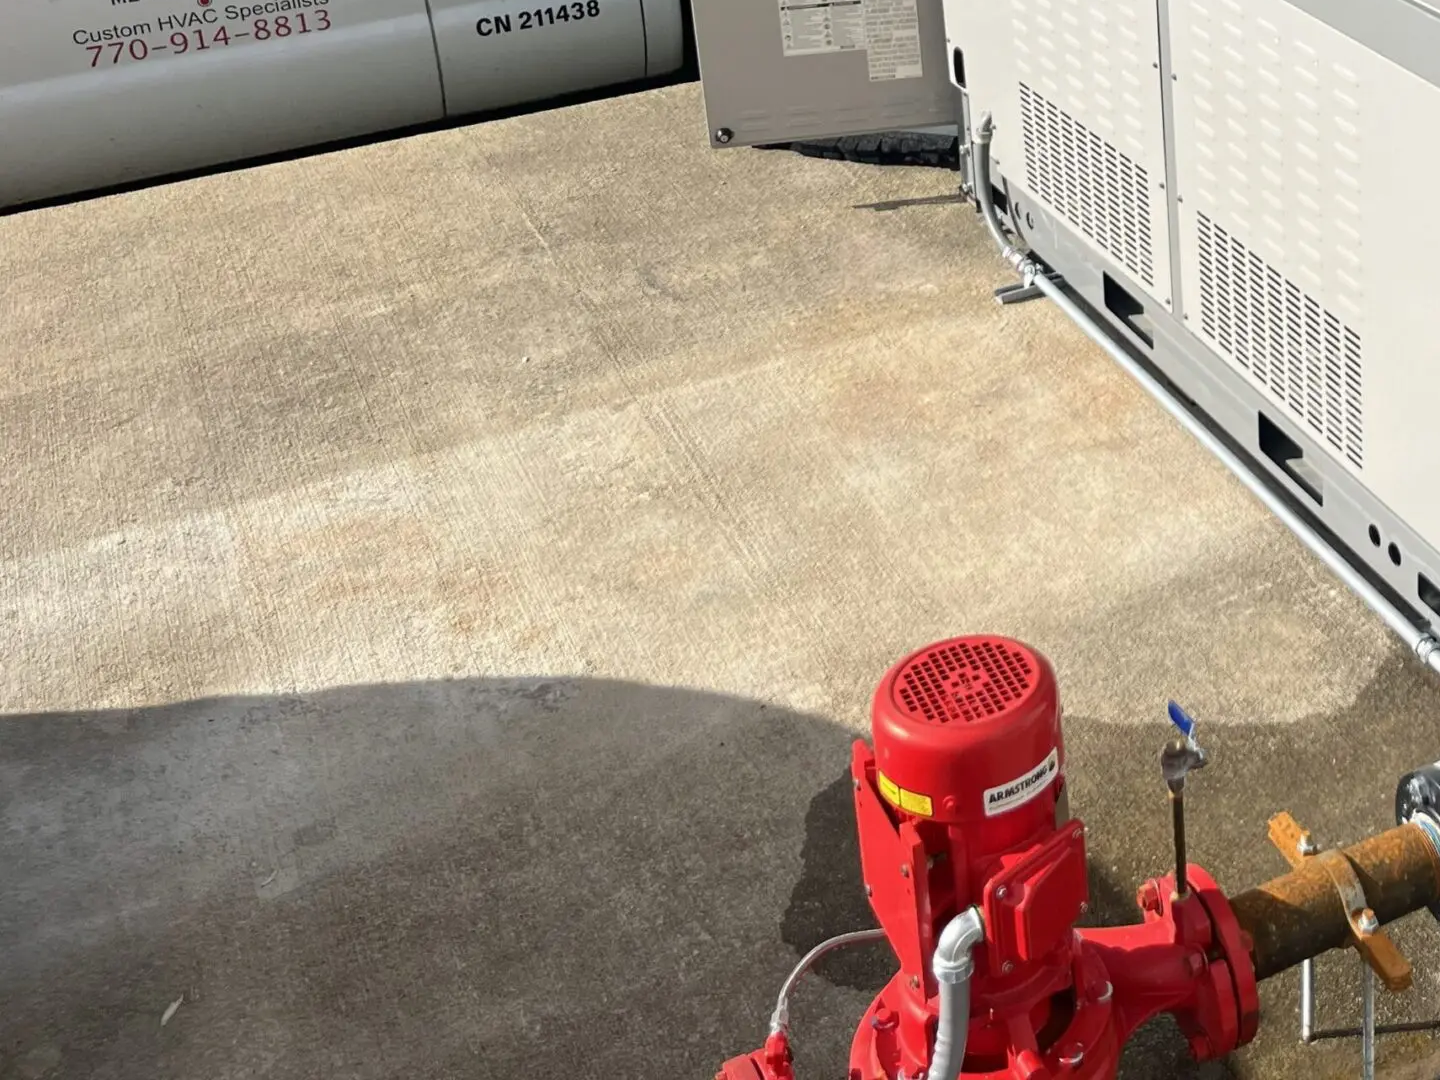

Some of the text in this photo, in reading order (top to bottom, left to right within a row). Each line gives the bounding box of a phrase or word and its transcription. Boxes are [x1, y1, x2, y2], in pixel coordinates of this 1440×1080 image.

[72, 22, 151, 46] Custom
[158, 9, 218, 32] HVAC
[476, 0, 600, 37] CN 211438
[86, 9, 332, 68] 770-914-8813
[989, 765, 1048, 804] ARMSTRONG
